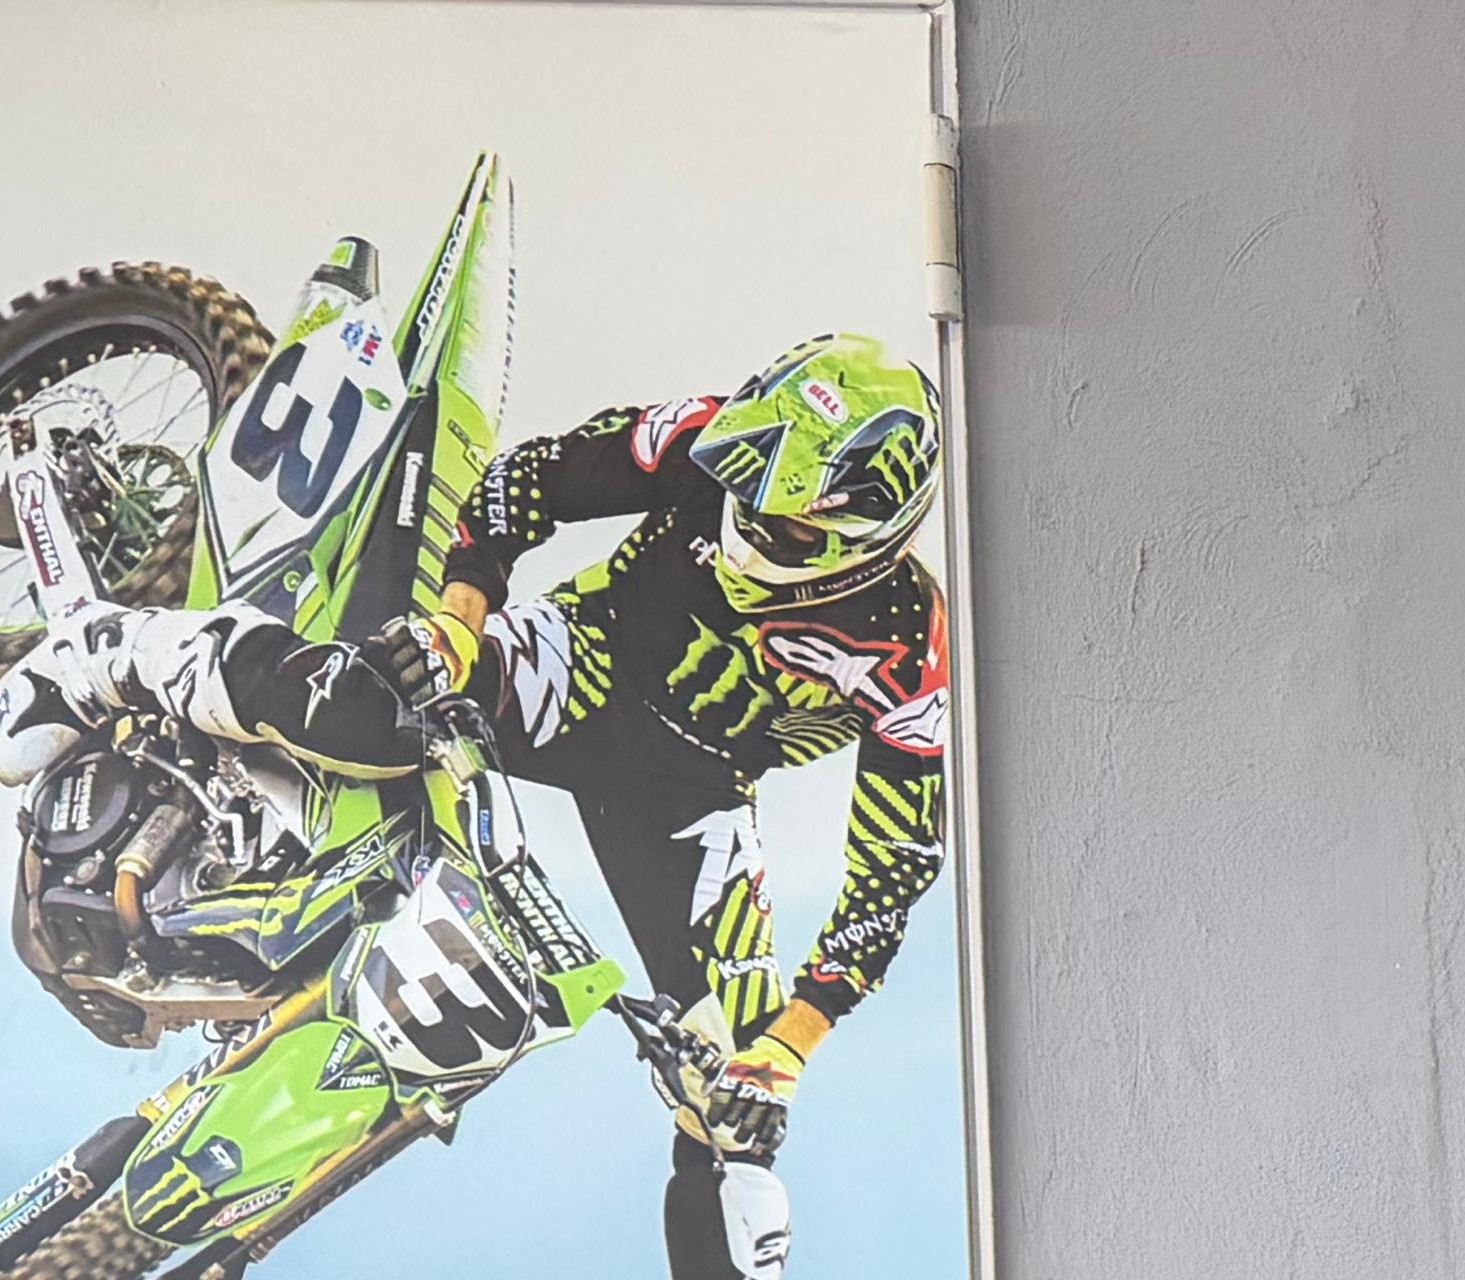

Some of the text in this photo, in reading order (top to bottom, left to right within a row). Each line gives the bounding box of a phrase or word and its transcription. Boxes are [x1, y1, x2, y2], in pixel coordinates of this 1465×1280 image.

[231, 341, 363, 519] 3
[807, 384, 840, 416] BELL
[484, 452, 509, 537] ONSTER
[363, 917, 536, 1070] 3
[327, 1034, 351, 1073] TOMAC
[339, 1074, 381, 1089] TOMAC
